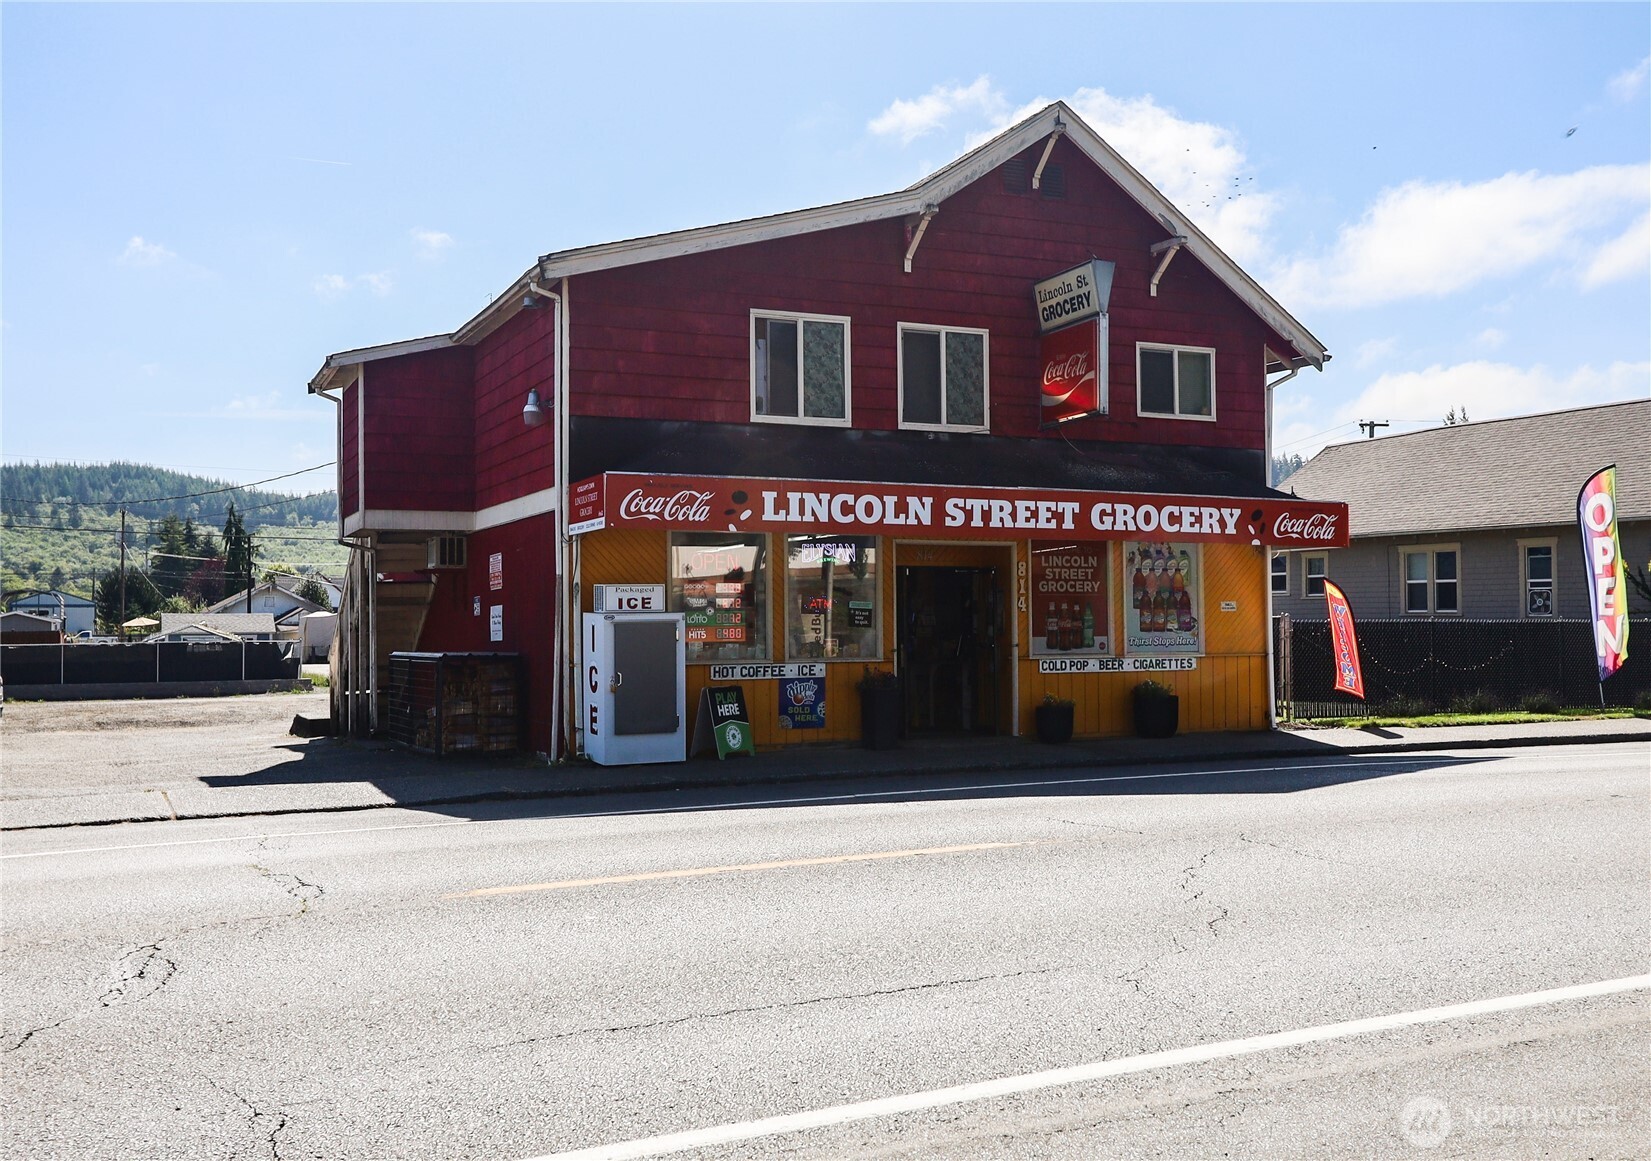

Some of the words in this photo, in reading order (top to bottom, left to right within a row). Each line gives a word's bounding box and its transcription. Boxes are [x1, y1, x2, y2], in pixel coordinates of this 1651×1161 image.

[1038, 281, 1073, 304] Lincoln
[1041, 290, 1092, 323] GROCERY
[1043, 352, 1089, 386] Coca-Cola
[620, 488, 716, 522] Coca-Cola
[762, 490, 933, 525] LINCOLN
[945, 498, 1080, 530] STREET
[1090, 502, 1242, 535] GROCERY
[1273, 512, 1339, 541] Coca-Cola
[801, 543, 856, 563] ELYSIAN
[691, 553, 742, 571] OPEN
[1041, 555, 1098, 567] LINCOLN
[1045, 568, 1094, 580] STREET
[1584, 492, 1625, 657] OPEN
[1017, 561, 1027, 612] 814
[1038, 581, 1101, 592] GROCERY
[618, 597, 652, 610] ICE
[809, 598, 832, 609] ATM
[686, 613, 708, 623] LOTTO
[1129, 637, 1153, 647] Thirst
[1153, 636, 1175, 648] Stops
[1176, 636, 1197, 646] Here!
[1041, 660, 1067, 671] COLD
[1069, 660, 1089, 671] POP
[1099, 659, 1124, 670] BEER
[1133, 658, 1193, 670] CIGARETTES
[713, 666, 736, 678] HOT
[740, 665, 786, 678] COFFEE
[797, 665, 817, 676] ICE
[589, 624, 598, 736] ICE
[715, 692, 737, 704] PLAY
[717, 703, 740, 717] HERE
[787, 706, 810, 714] SOLD
[795, 714, 818, 722] HERE
